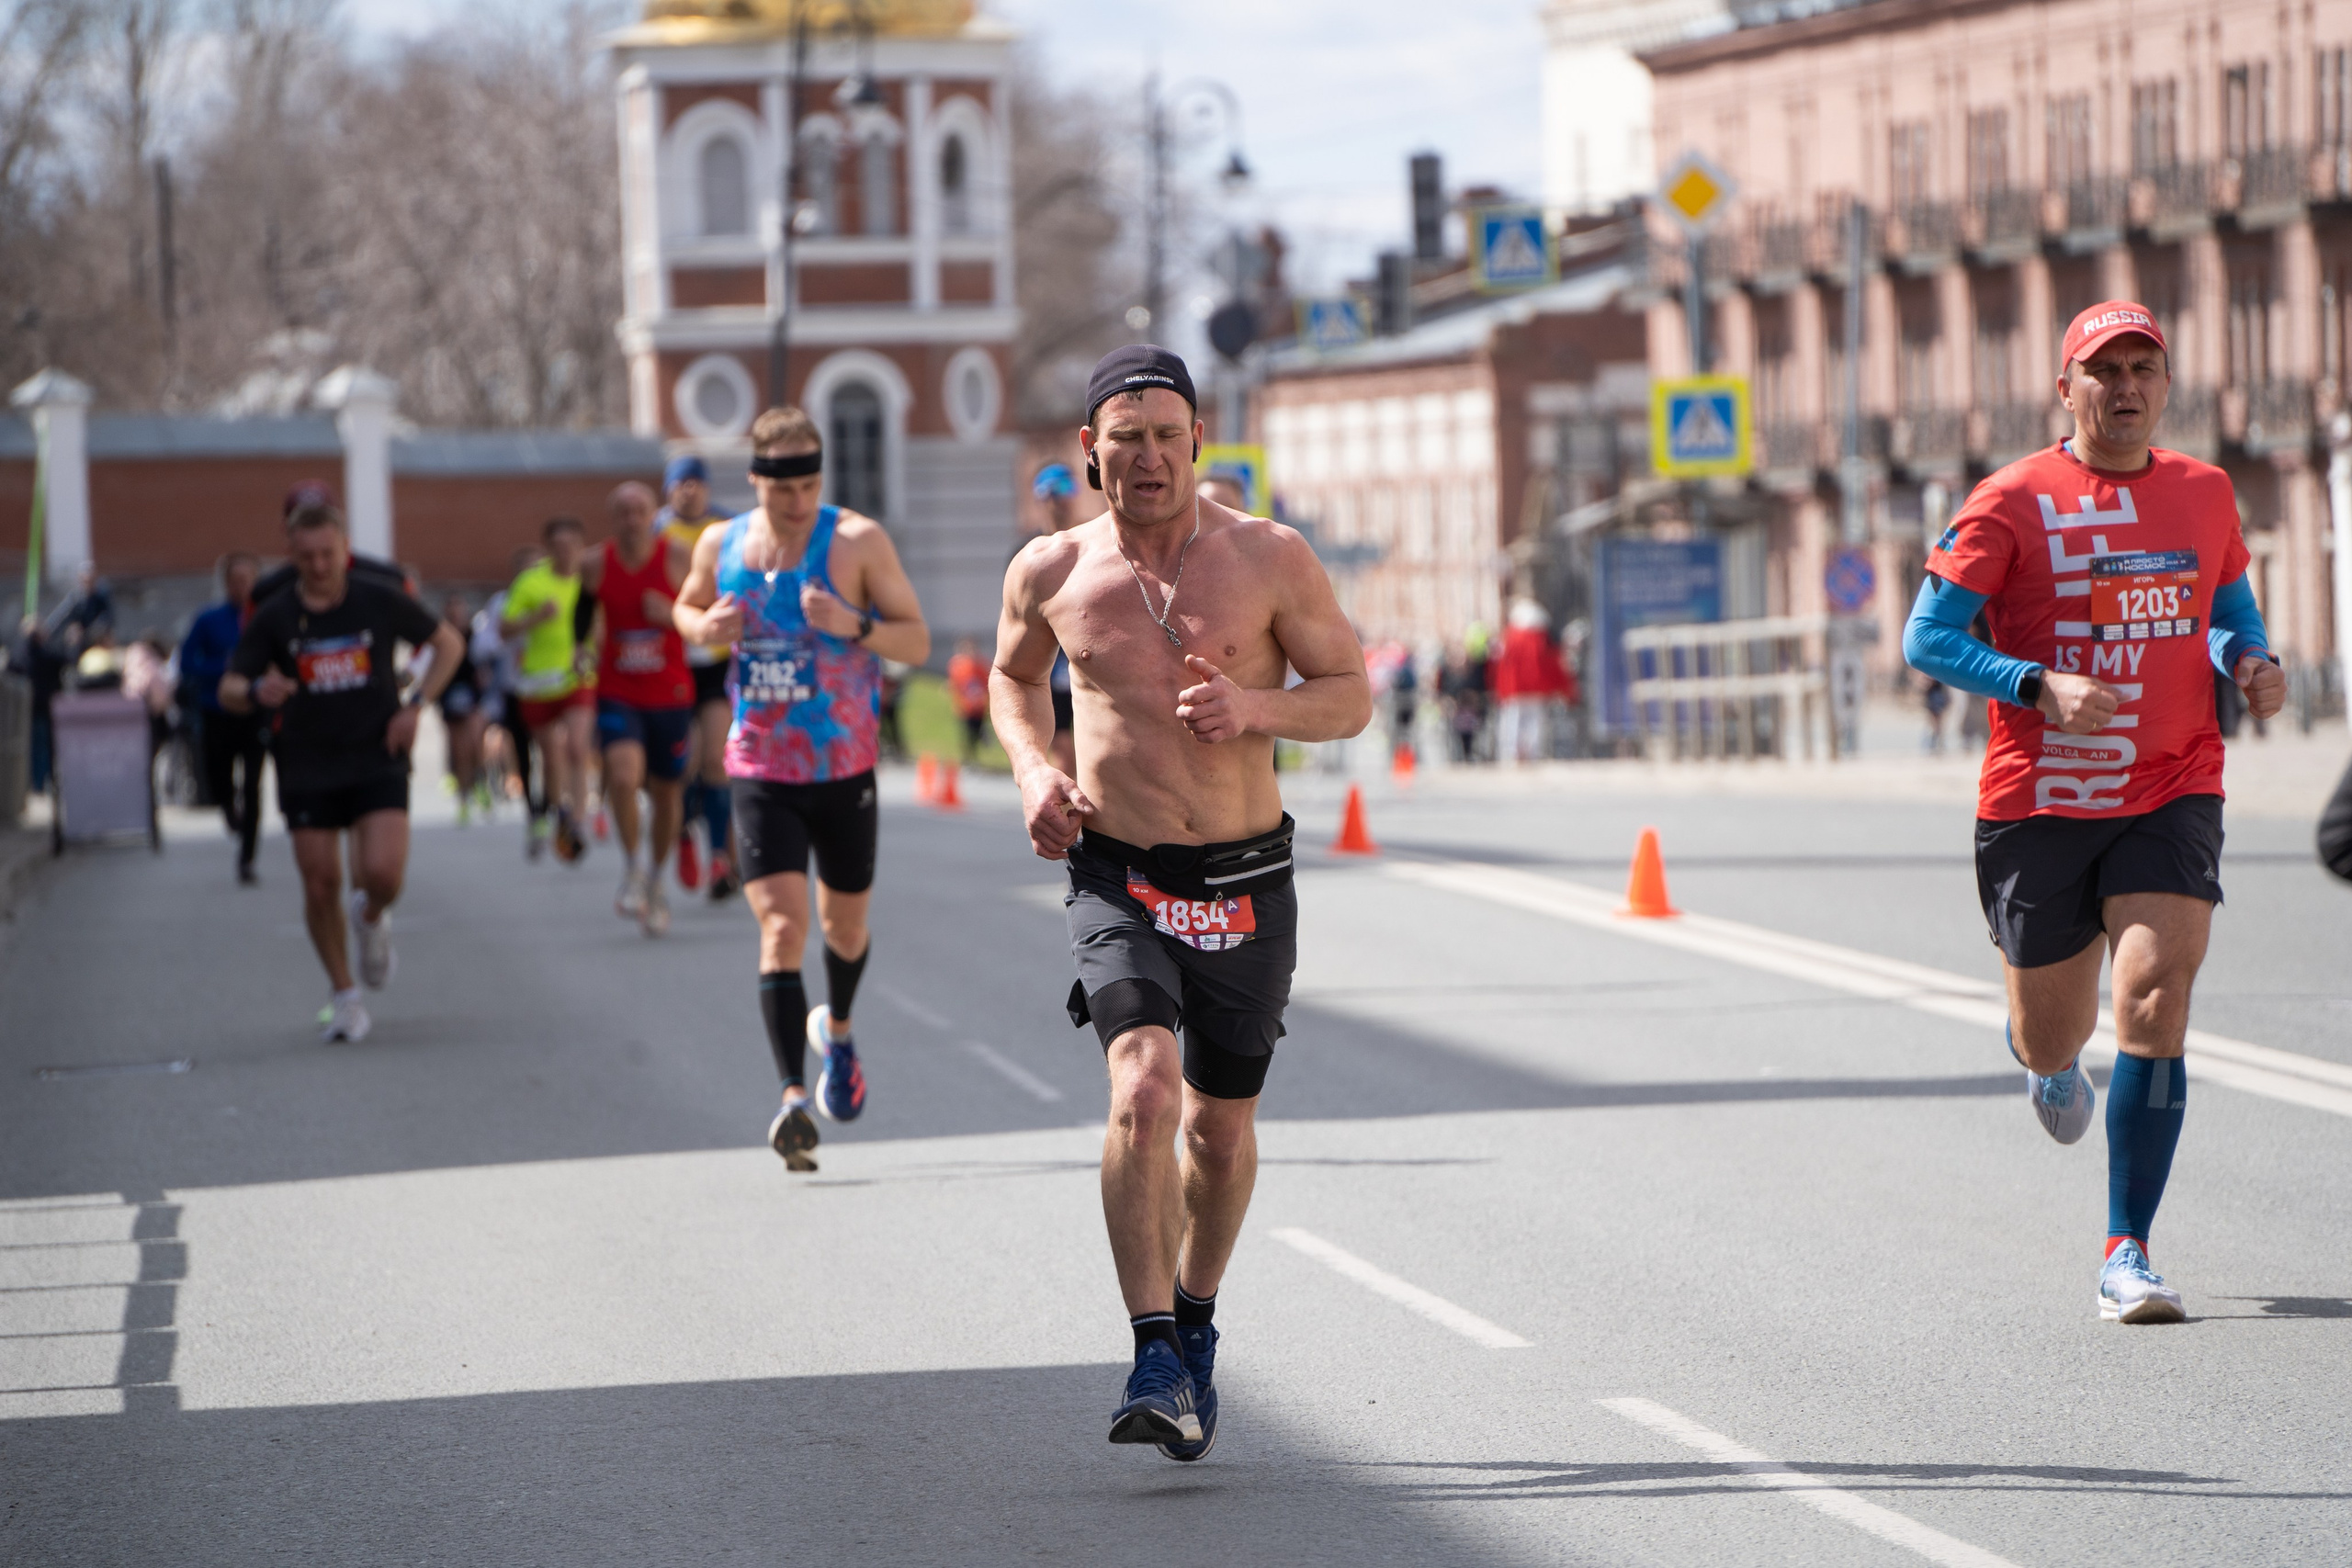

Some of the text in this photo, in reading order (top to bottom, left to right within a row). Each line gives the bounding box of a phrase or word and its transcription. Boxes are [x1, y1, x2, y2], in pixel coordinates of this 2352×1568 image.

[2083, 310, 2152, 335] RUSSIA
[1125, 375, 1174, 385] CHELYABINSK
[2133, 576, 2155, 584] ИГОРЬ
[2117, 586, 2179, 621] 1203
[2055, 643, 2146, 675] IS MY
[1156, 901, 1229, 931] 1854
